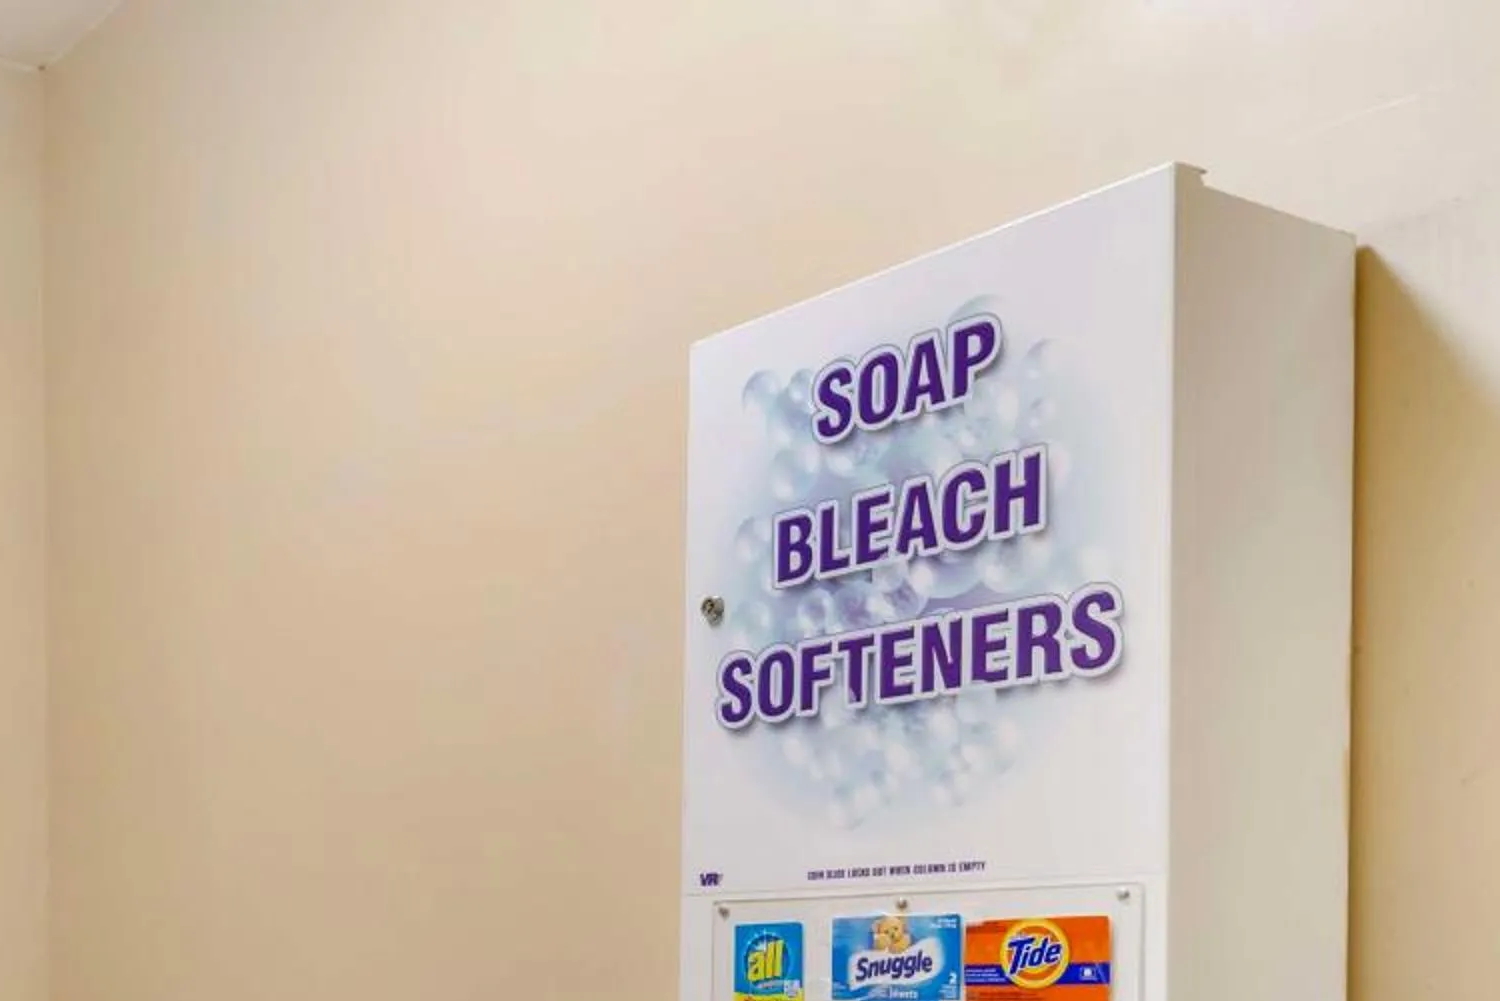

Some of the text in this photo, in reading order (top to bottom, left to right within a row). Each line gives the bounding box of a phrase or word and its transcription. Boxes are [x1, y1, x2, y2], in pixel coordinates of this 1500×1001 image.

[816, 320, 997, 437] SOAP
[777, 451, 1042, 583] BLEACH
[720, 589, 1116, 723] SOFTENERS
[959, 861, 986, 872] EMPTY
[747, 939, 784, 981] all
[855, 949, 933, 982] Snuggle
[1008, 937, 1063, 976] Tide
